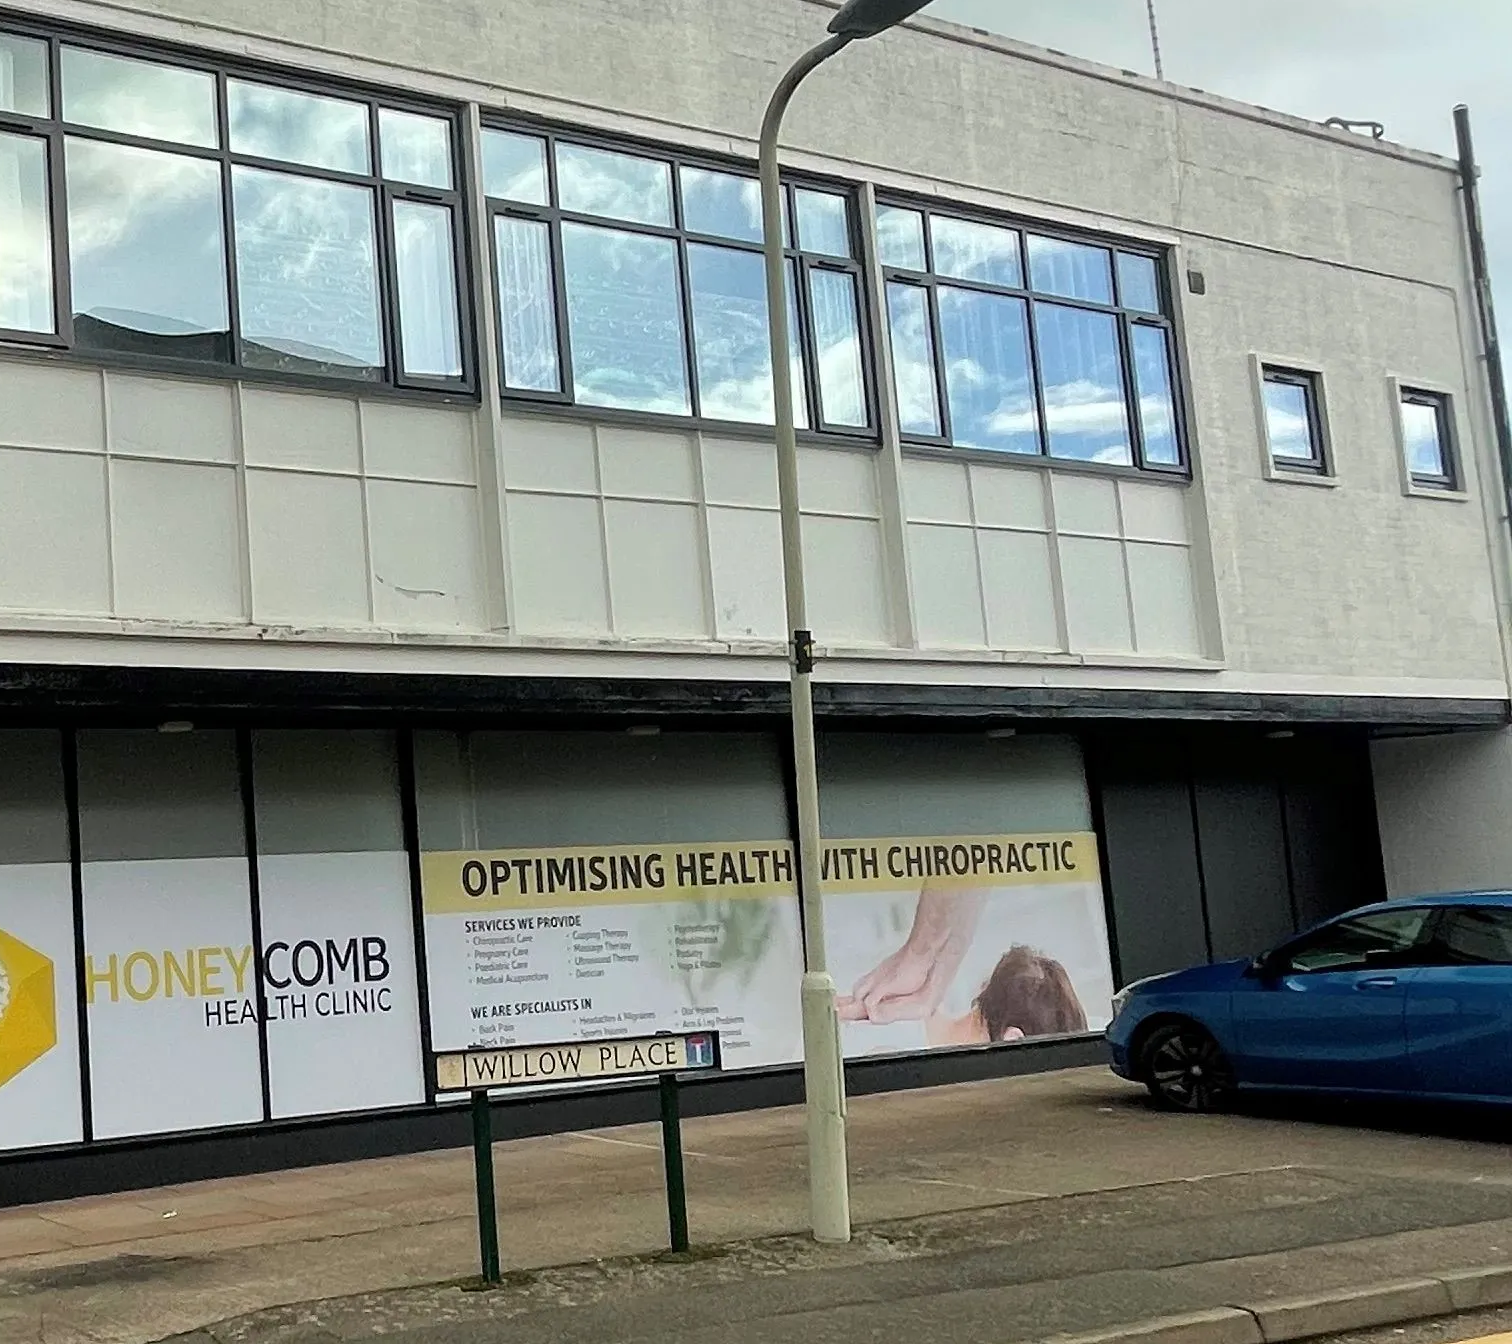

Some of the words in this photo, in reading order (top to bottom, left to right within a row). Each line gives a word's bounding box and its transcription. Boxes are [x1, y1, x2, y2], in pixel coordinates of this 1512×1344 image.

[461, 853, 665, 897] OPTIMISING
[676, 849, 793, 886] HEALTH
[888, 840, 1076, 878] CHIROPRACTIC
[465, 918, 515, 933] SERVICES
[517, 917, 534, 930] WE
[538, 915, 582, 928] PROVIDE
[205, 993, 307, 1027] HEALTH
[315, 988, 392, 1016] CLINIC
[471, 1005, 487, 1019] WE
[491, 1004, 512, 1017] ARE
[515, 999, 579, 1015] SPECIALISTS
[581, 998, 592, 1009] IN
[473, 1047, 582, 1080] WILLOW
[599, 1041, 677, 1071] PLACE
